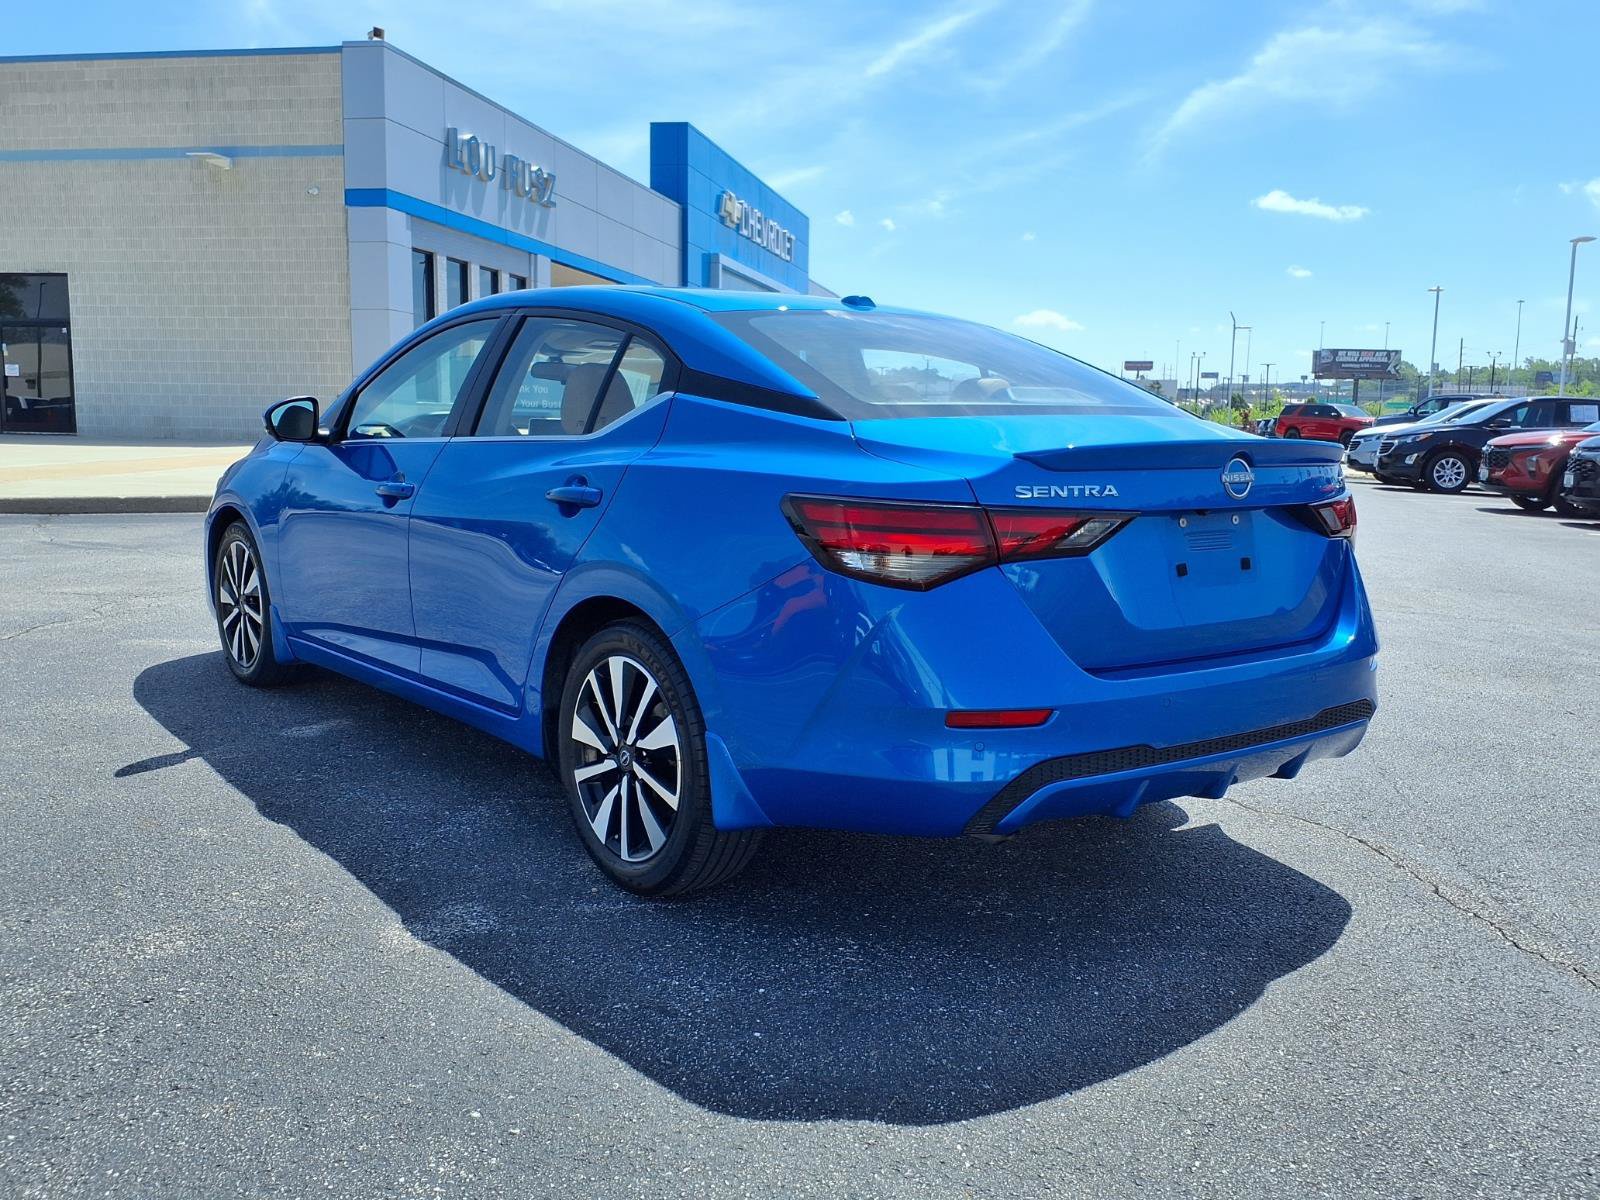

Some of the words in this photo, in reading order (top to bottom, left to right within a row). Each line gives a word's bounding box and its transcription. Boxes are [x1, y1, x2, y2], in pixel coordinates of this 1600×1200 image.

[448, 127, 495, 182] LOU
[503, 154, 556, 208] FUSZ
[739, 200, 796, 262] CHEVROLET
[532, 385, 549, 394] You
[521, 399, 539, 408] Your
[1221, 471, 1255, 484] NISSAN
[1014, 484, 1119, 499] SENTRA
